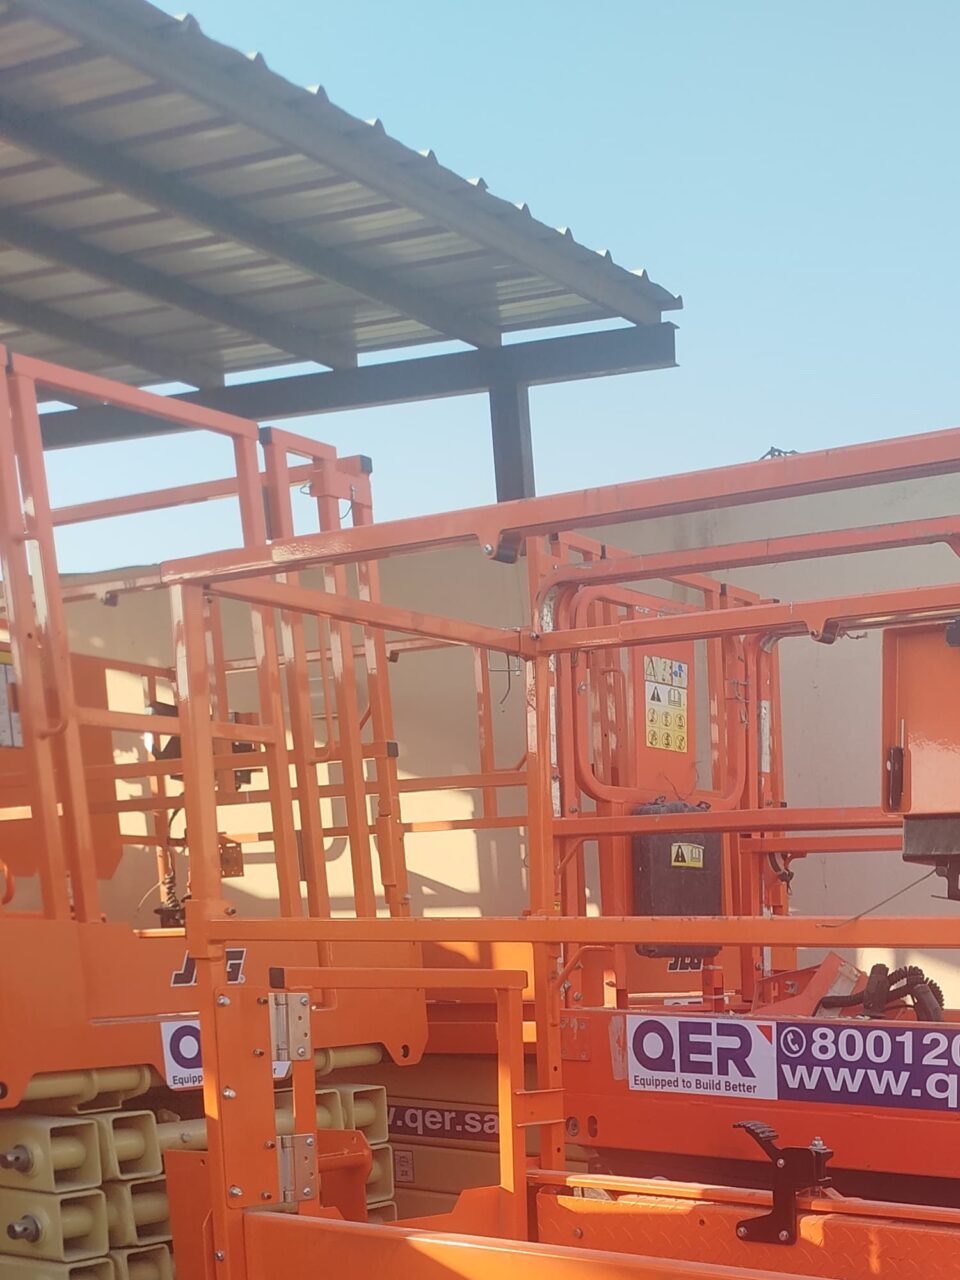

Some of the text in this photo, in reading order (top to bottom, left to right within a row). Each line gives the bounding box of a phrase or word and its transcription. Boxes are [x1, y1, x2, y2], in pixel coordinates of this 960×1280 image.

[170, 948, 246, 987] JG
[632, 1019, 756, 1078] QER
[172, 1074, 204, 1086] Equipp
[633, 1075, 757, 1093] Equipped to Build Better
[388, 1107, 500, 1135] .qer.sa
